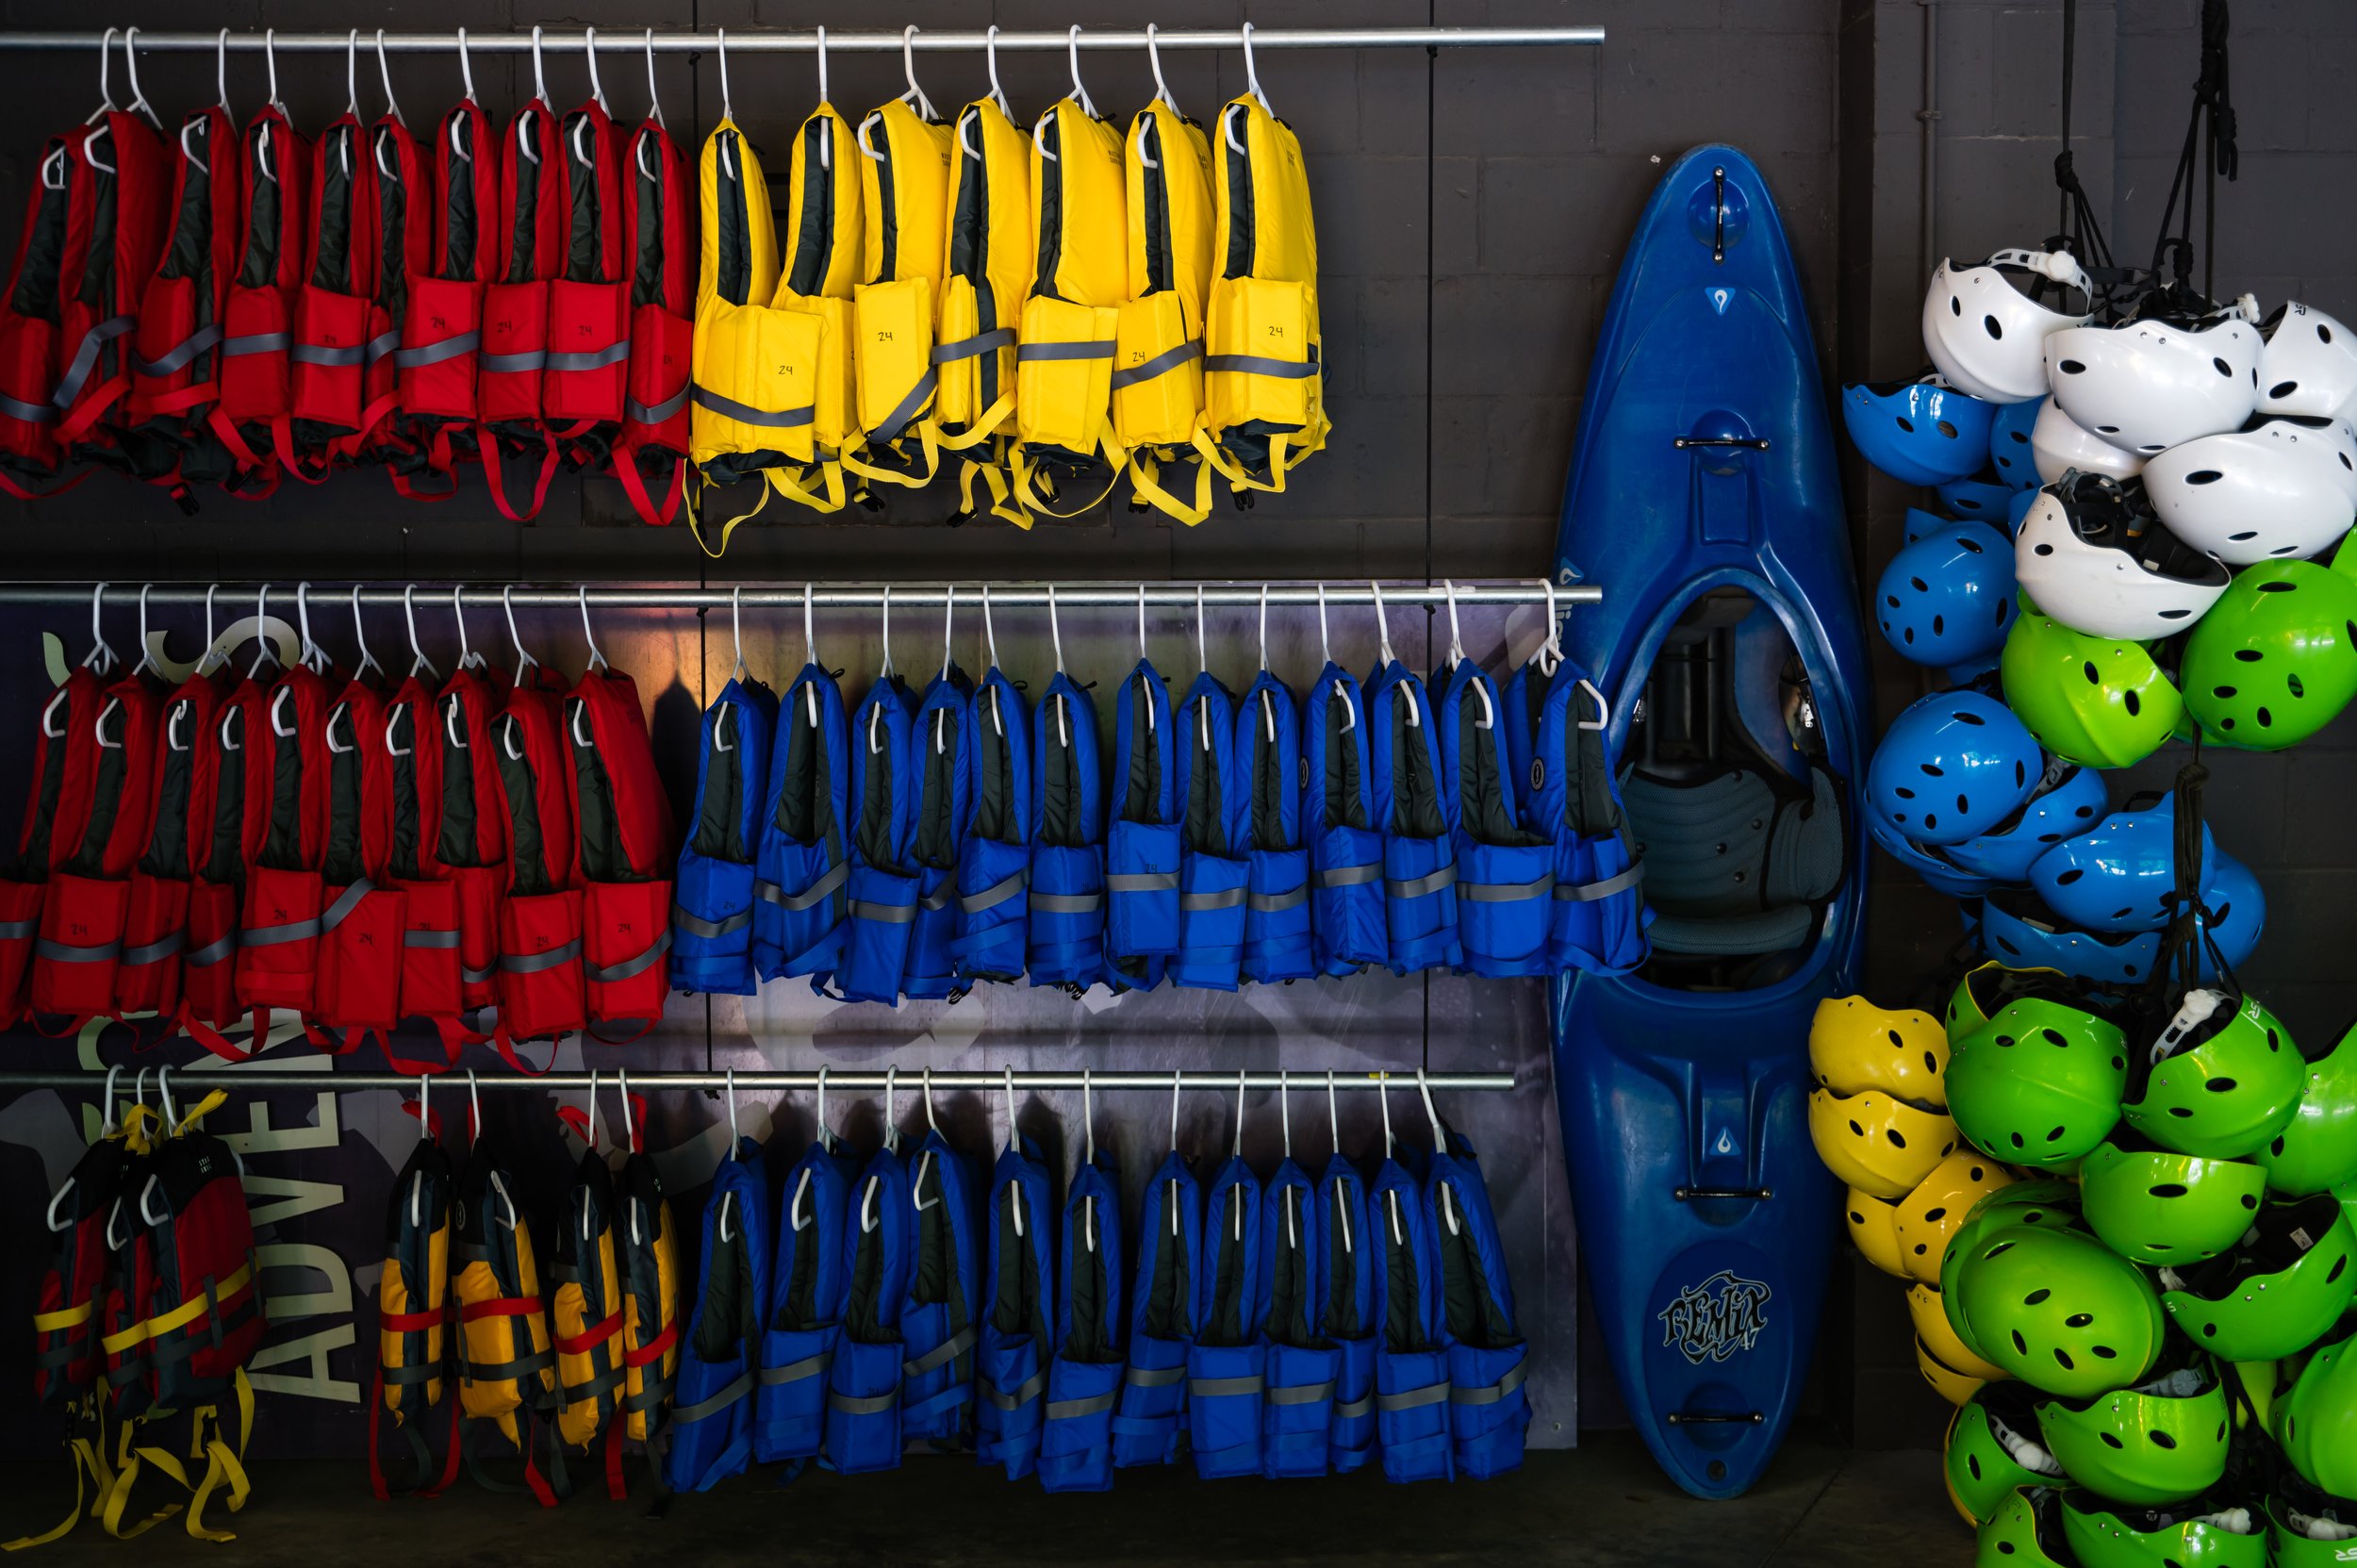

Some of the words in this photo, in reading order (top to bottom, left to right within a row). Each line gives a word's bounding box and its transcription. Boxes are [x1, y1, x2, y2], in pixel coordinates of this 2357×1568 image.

[430, 317, 445, 330] 24
[498, 320, 513, 334] 24
[579, 324, 593, 338] 24
[879, 331, 895, 342] 24
[1269, 325, 1283, 338] 24
[323, 334, 338, 346] 24
[664, 354, 674, 365] 24
[1133, 351, 1146, 363] 24
[779, 365, 794, 376] 24
[1145, 863, 1158, 875] 24
[724, 900, 737, 911] 24
[273, 908, 288, 920] 24
[71, 923, 90, 936] 24
[618, 923, 632, 934] 24
[358, 933, 373, 946] 24
[537, 935, 551, 949] 24
[1739, 1327, 1761, 1351] 47
